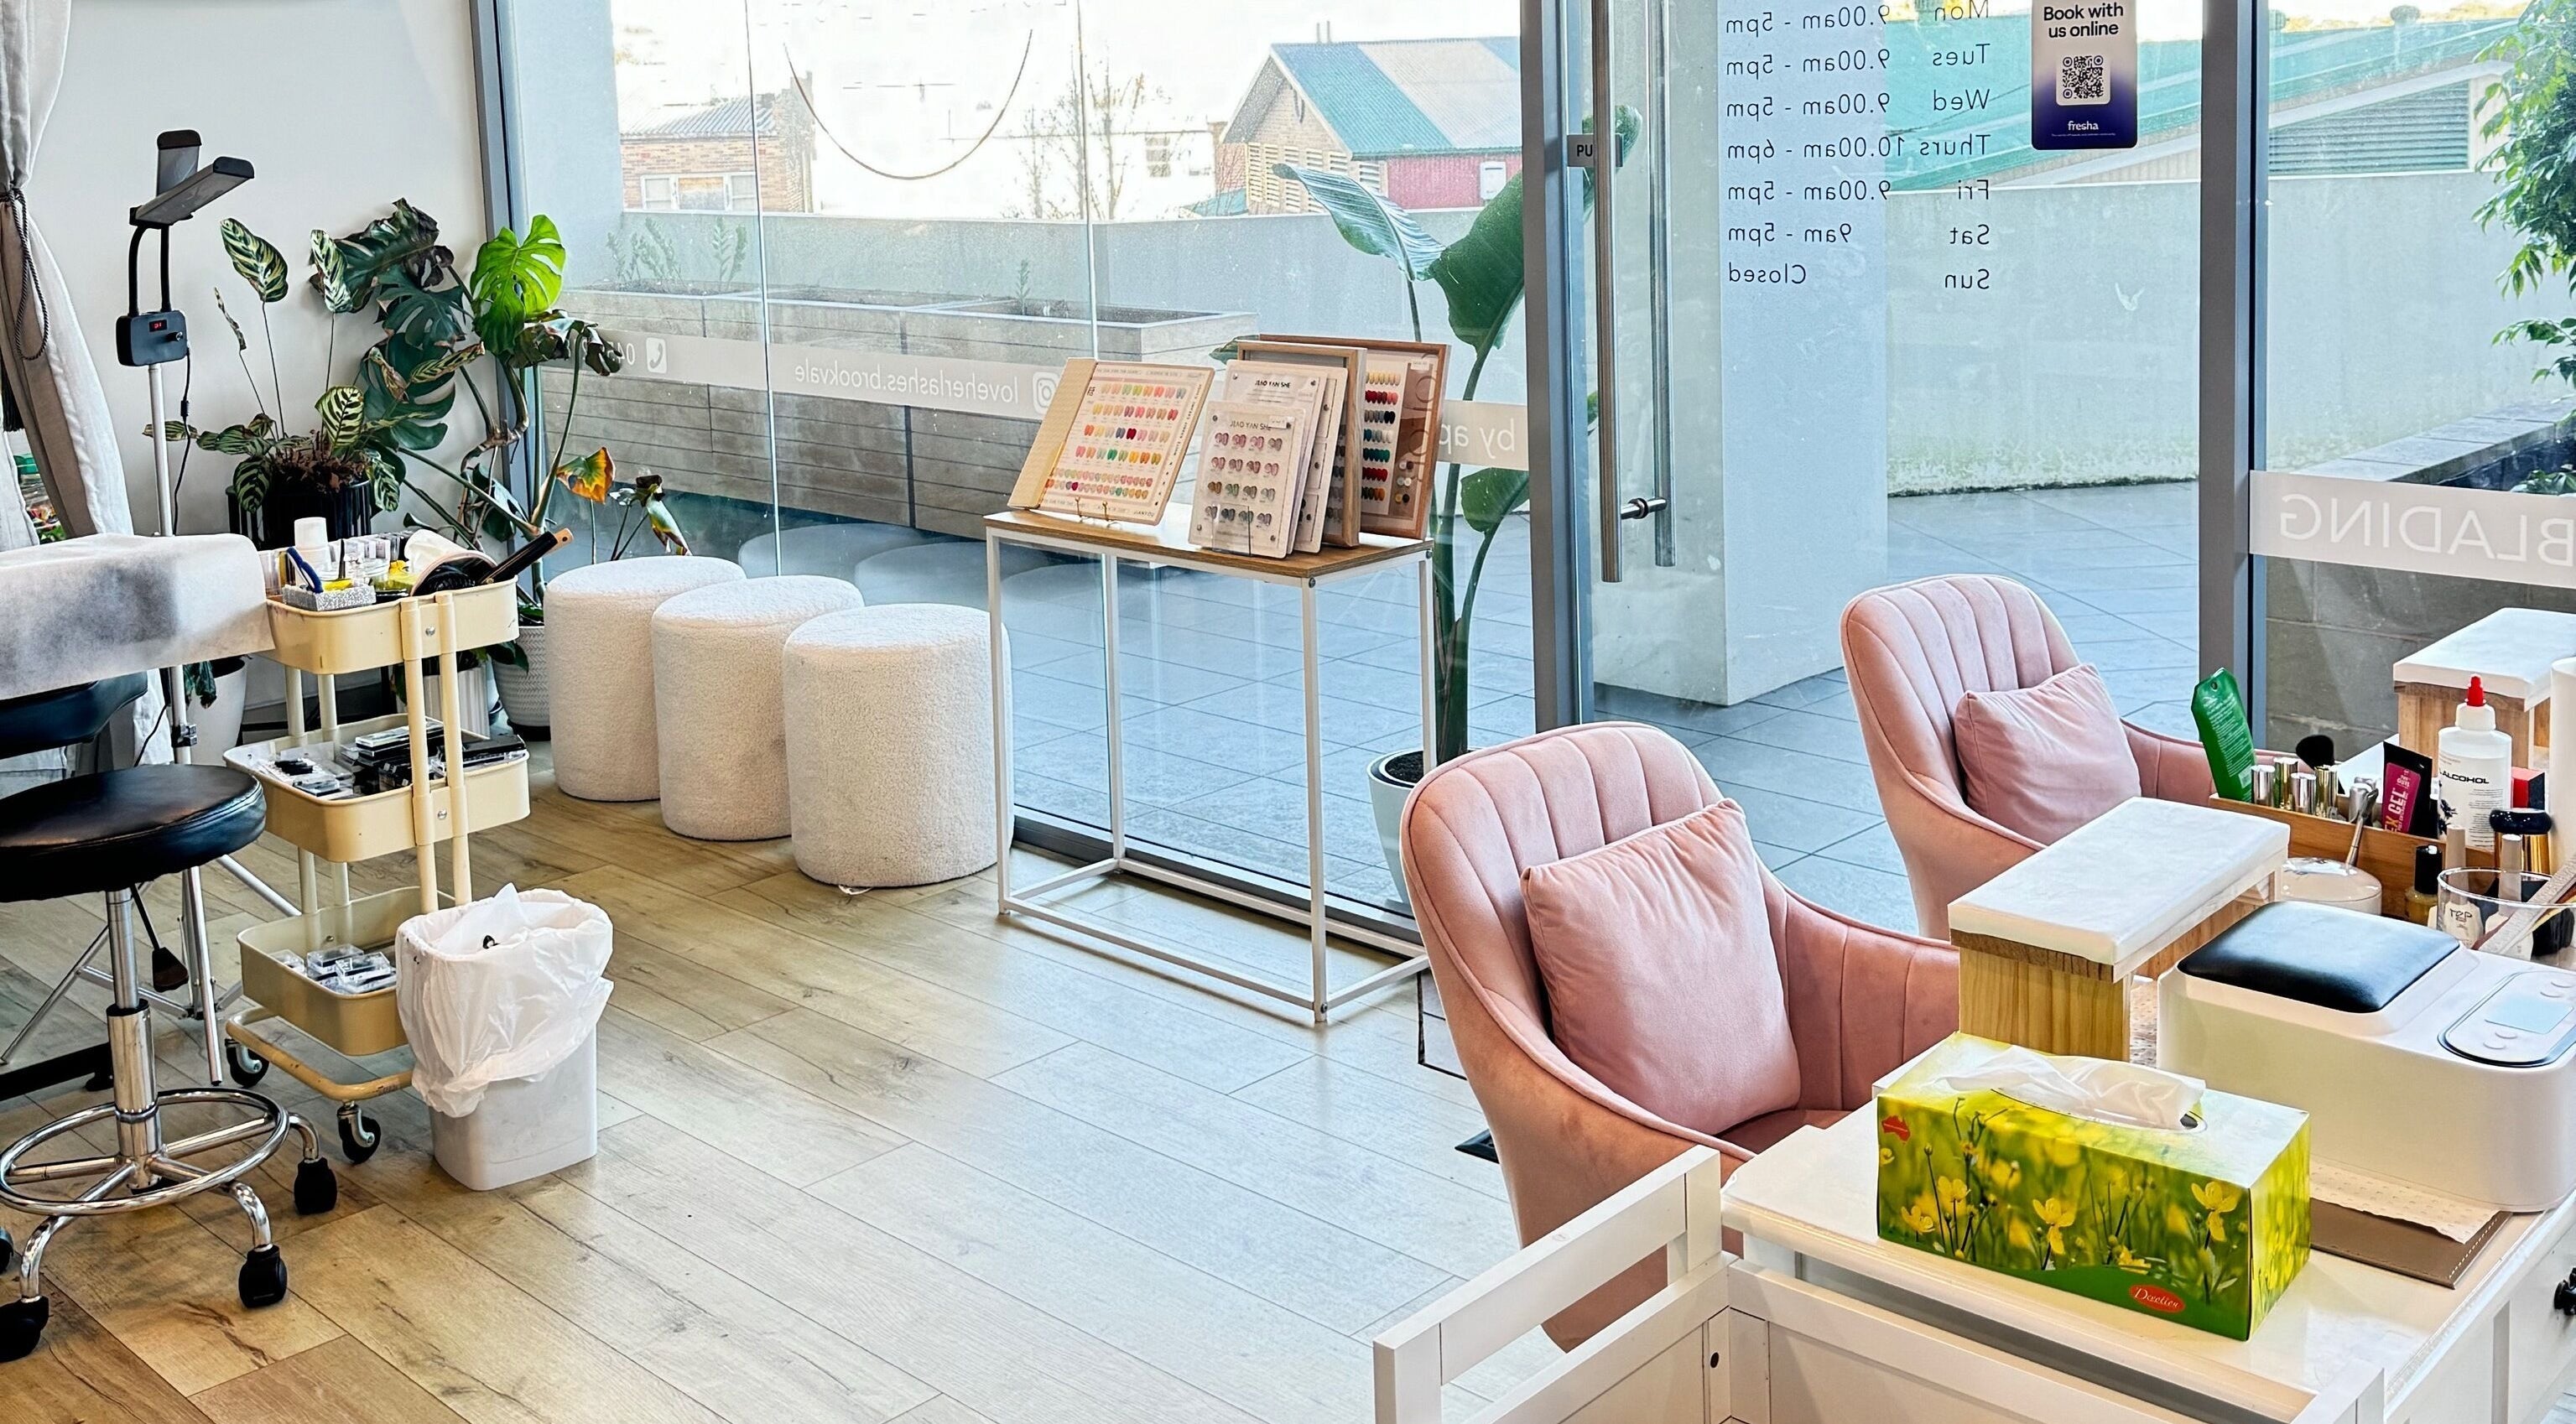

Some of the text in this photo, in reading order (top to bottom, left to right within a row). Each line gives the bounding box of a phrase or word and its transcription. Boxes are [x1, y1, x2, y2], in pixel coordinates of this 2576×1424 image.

[2043, 2, 2124, 21] Book with
[2048, 21, 2119, 38] us online
[2067, 120, 2100, 131] fresha
[1576, 143, 1593, 157] PU
[2442, 771, 2490, 784] ALCOHOL
[2388, 787, 2408, 815] GEL
